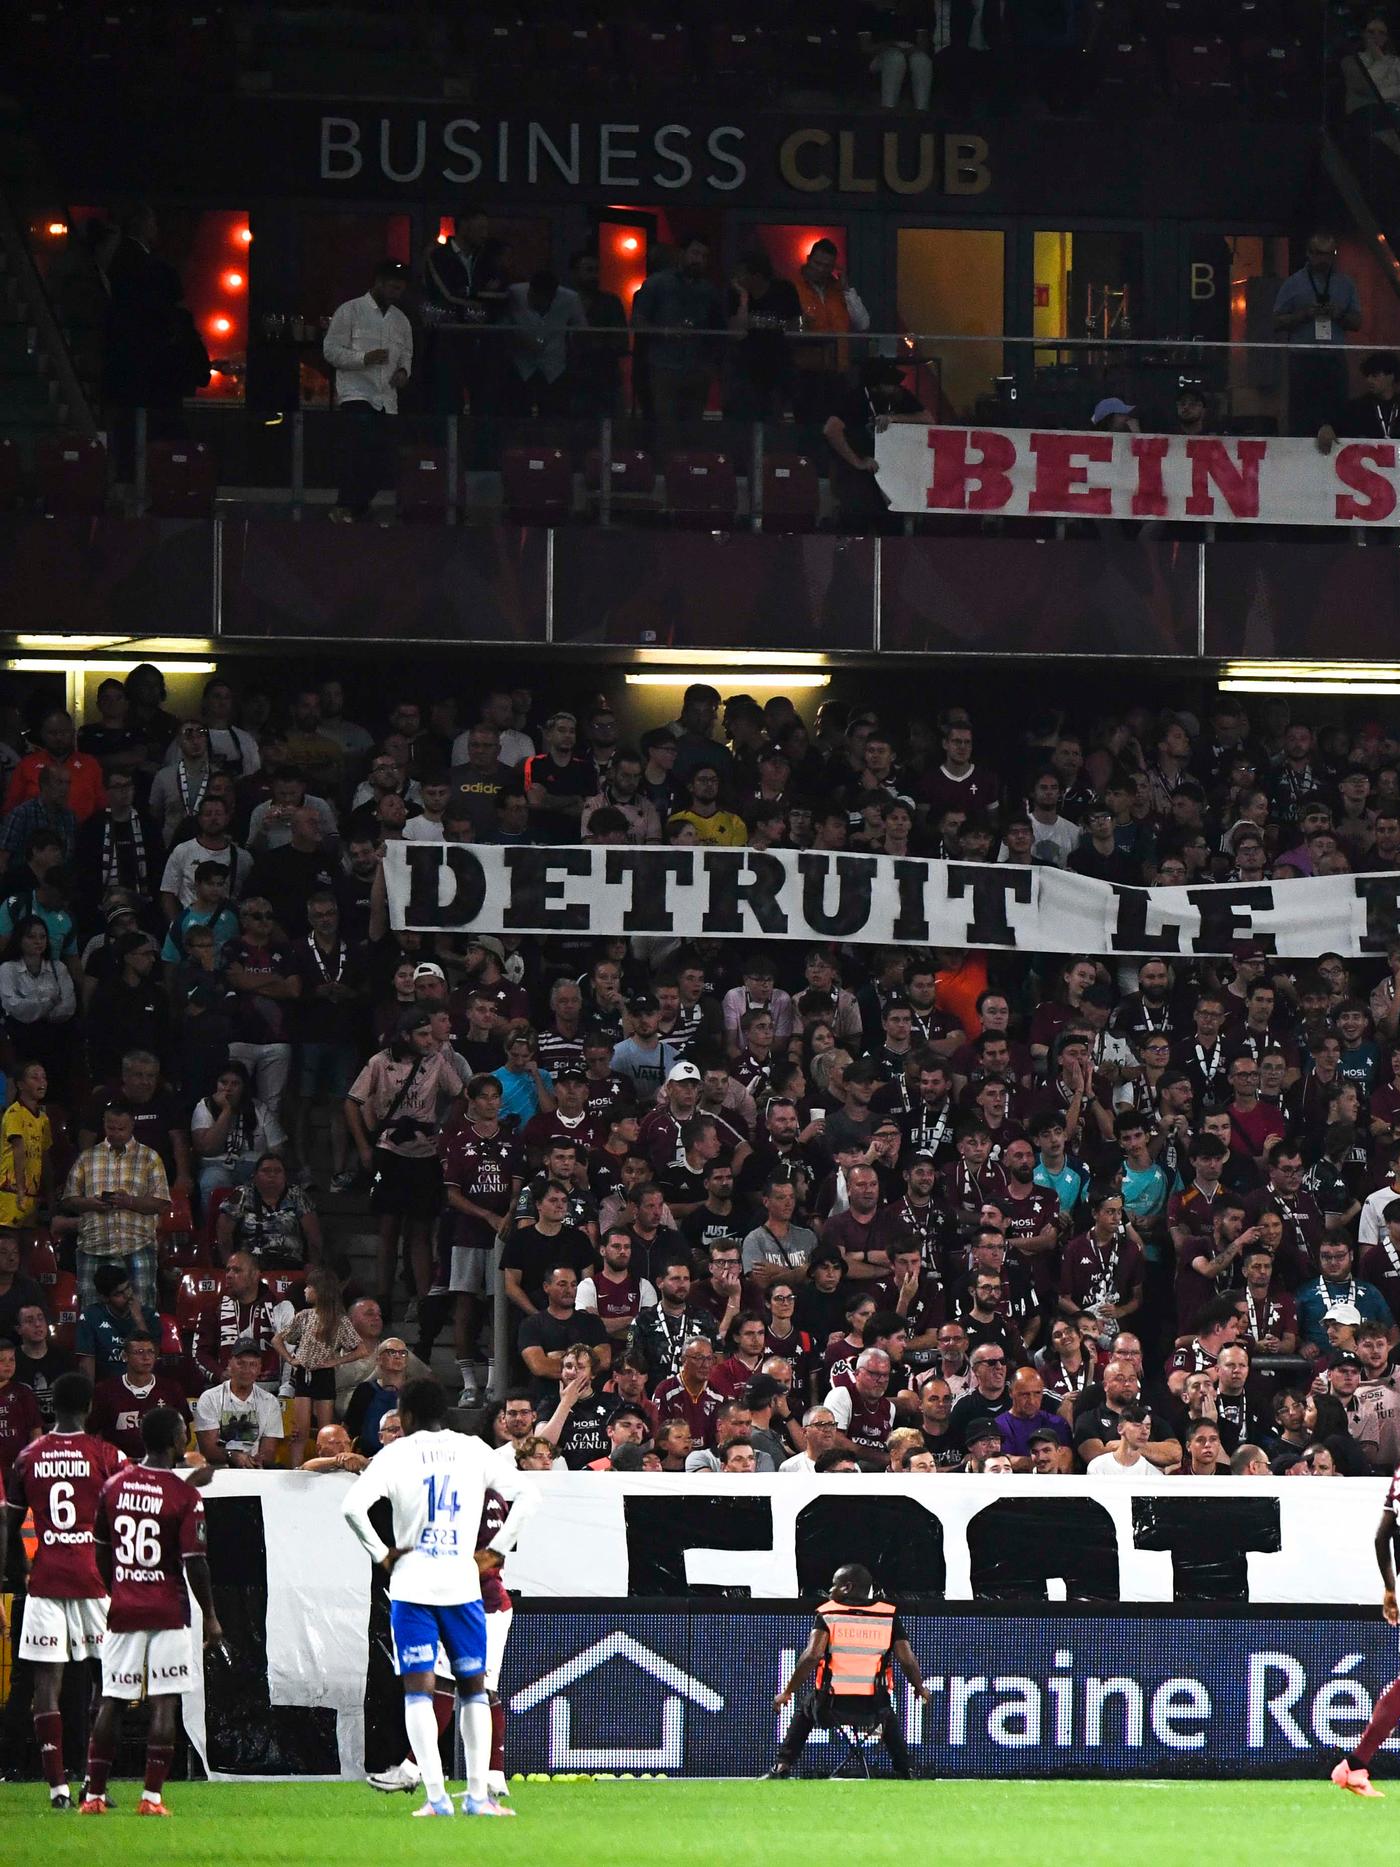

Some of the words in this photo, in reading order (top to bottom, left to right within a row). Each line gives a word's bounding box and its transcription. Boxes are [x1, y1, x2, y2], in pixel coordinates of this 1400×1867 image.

[319, 116, 748, 191] BUSINESS
[779, 128, 992, 196] CLUB
[1191, 262, 1216, 300] B
[926, 429, 1268, 519] BEIN
[405, 845, 1031, 946] DETRUIT
[1111, 885, 1276, 955] LE
[1343, 1068, 1367, 1077] MOSL
[589, 1097, 614, 1107] MOSL
[478, 1164, 502, 1173] MOSL
[477, 1174, 501, 1184] CAR
[1011, 1218, 1035, 1227] MOSL
[705, 1225, 729, 1237] JUST
[572, 1419, 601, 1429] MOSL
[572, 1432, 600, 1442] CAR
[564, 1440, 608, 1450] AVENUE
[34, 1460, 91, 1478] NDUQUIDI
[116, 1492, 163, 1515] JALLOW
[423, 1473, 461, 1523] 14
[49, 1481, 76, 1530] 6
[114, 1514, 162, 1567] 36
[33, 1635, 58, 1646] LCR
[161, 1666, 188, 1679] LCR
[778, 1649, 1212, 1748] Lrraine
